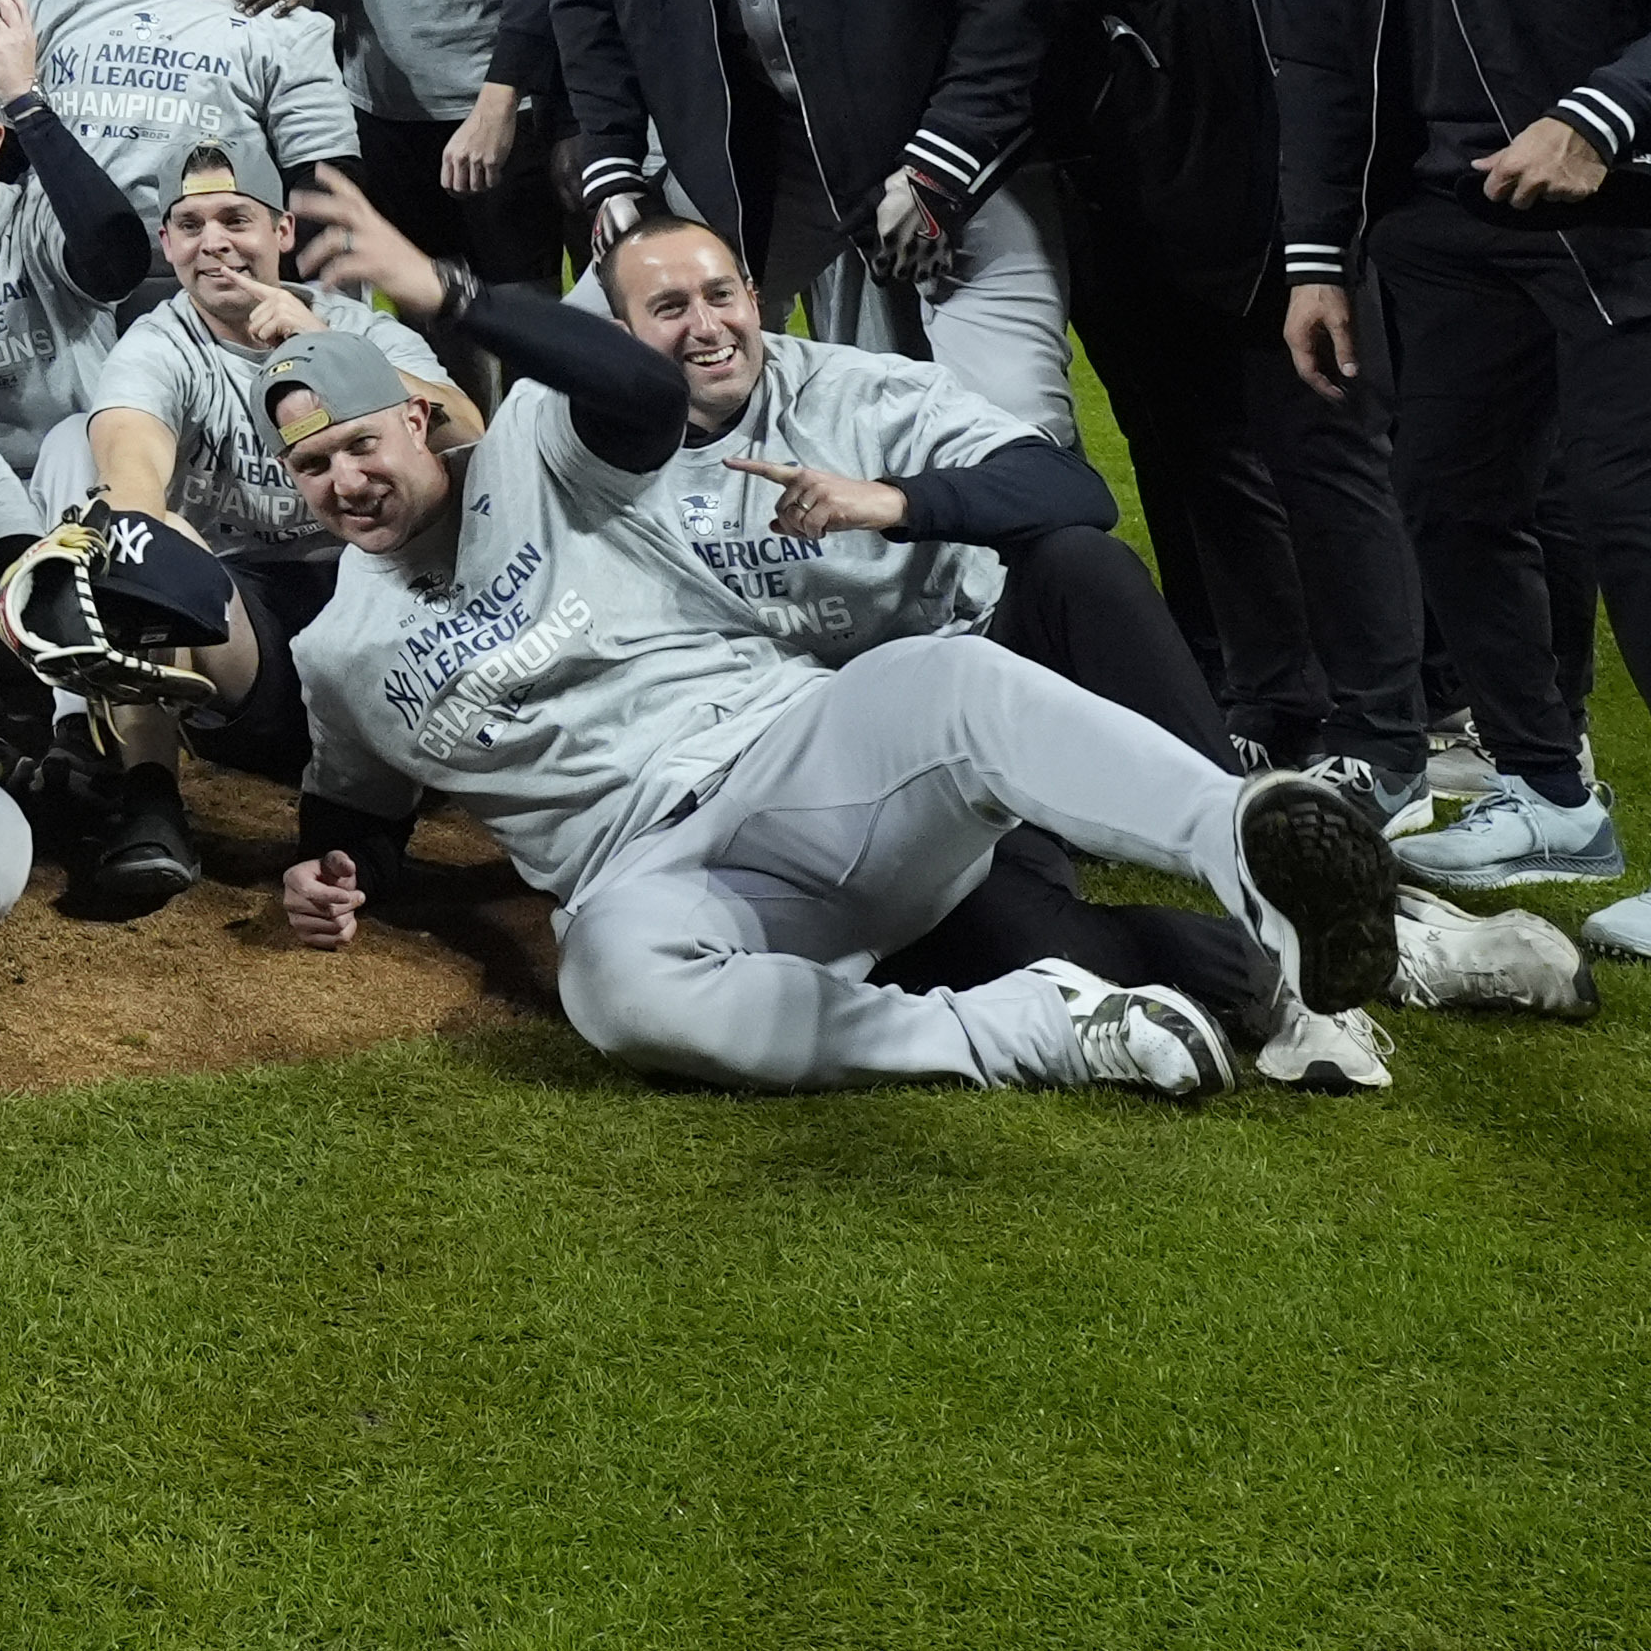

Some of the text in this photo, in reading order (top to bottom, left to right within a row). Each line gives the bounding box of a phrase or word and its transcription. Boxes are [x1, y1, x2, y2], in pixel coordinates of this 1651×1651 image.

[91, 67, 189, 94] LEAGUE
[96, 44, 231, 78] AMERICAN
[47, 91, 223, 132] CHAMPIONS
[101, 125, 139, 141] ALCS
[404, 541, 545, 665] AMERICAN
[420, 600, 531, 694] LEAGUE
[415, 589, 592, 762] CHAMPIONS
